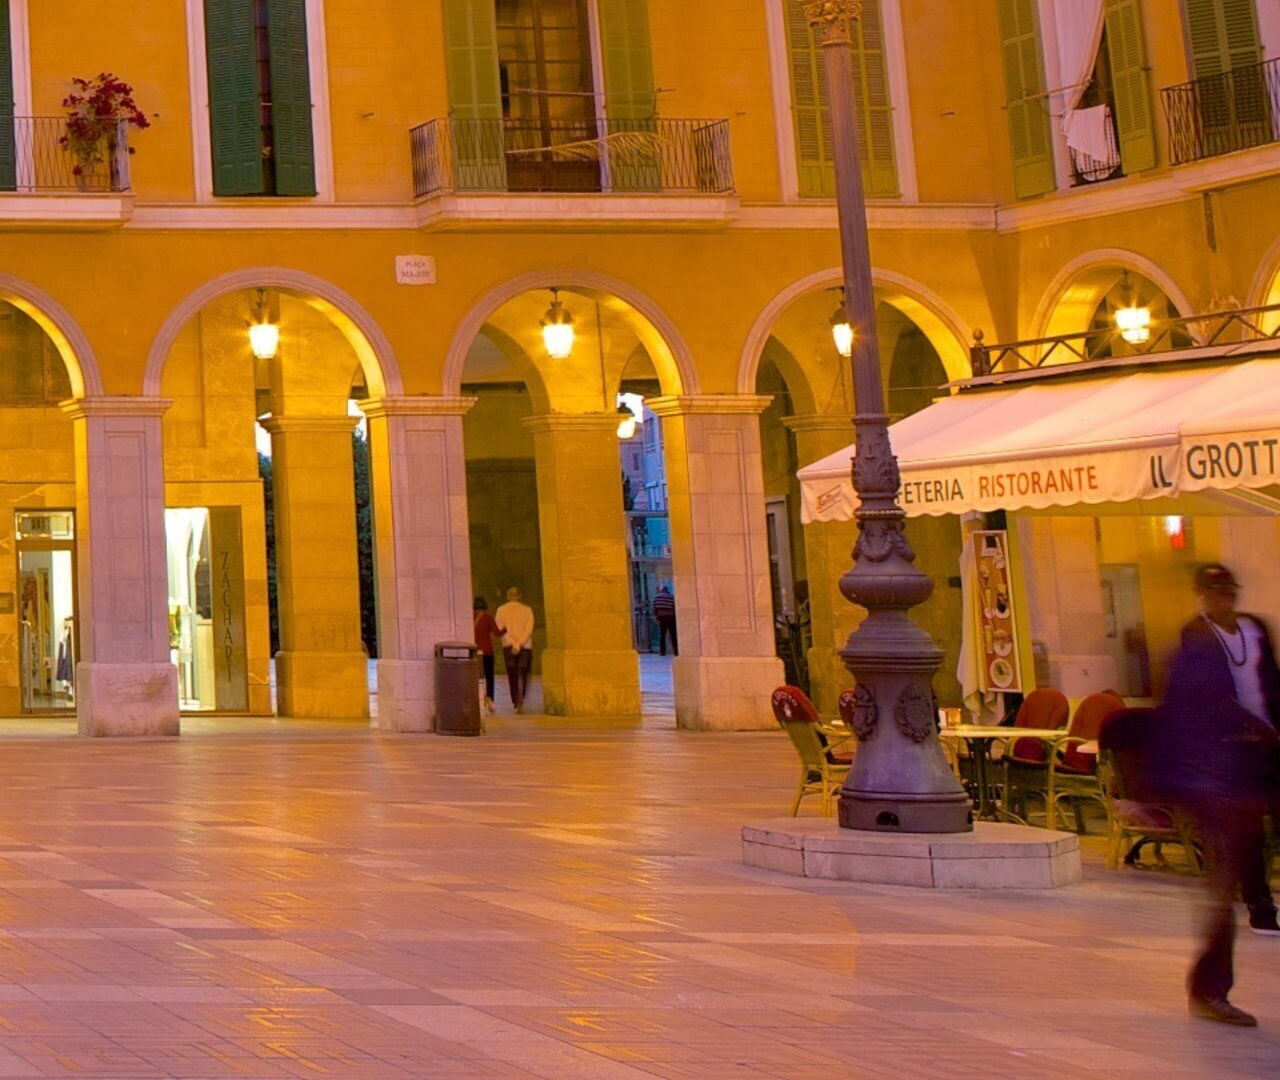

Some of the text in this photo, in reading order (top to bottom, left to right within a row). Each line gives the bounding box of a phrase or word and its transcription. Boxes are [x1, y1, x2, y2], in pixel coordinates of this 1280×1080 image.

[897, 454, 1173, 504] FETERIA RISTORANTE IL
[1186, 438, 1279, 481] GROTT
[221, 551, 233, 682] ZACHARI
